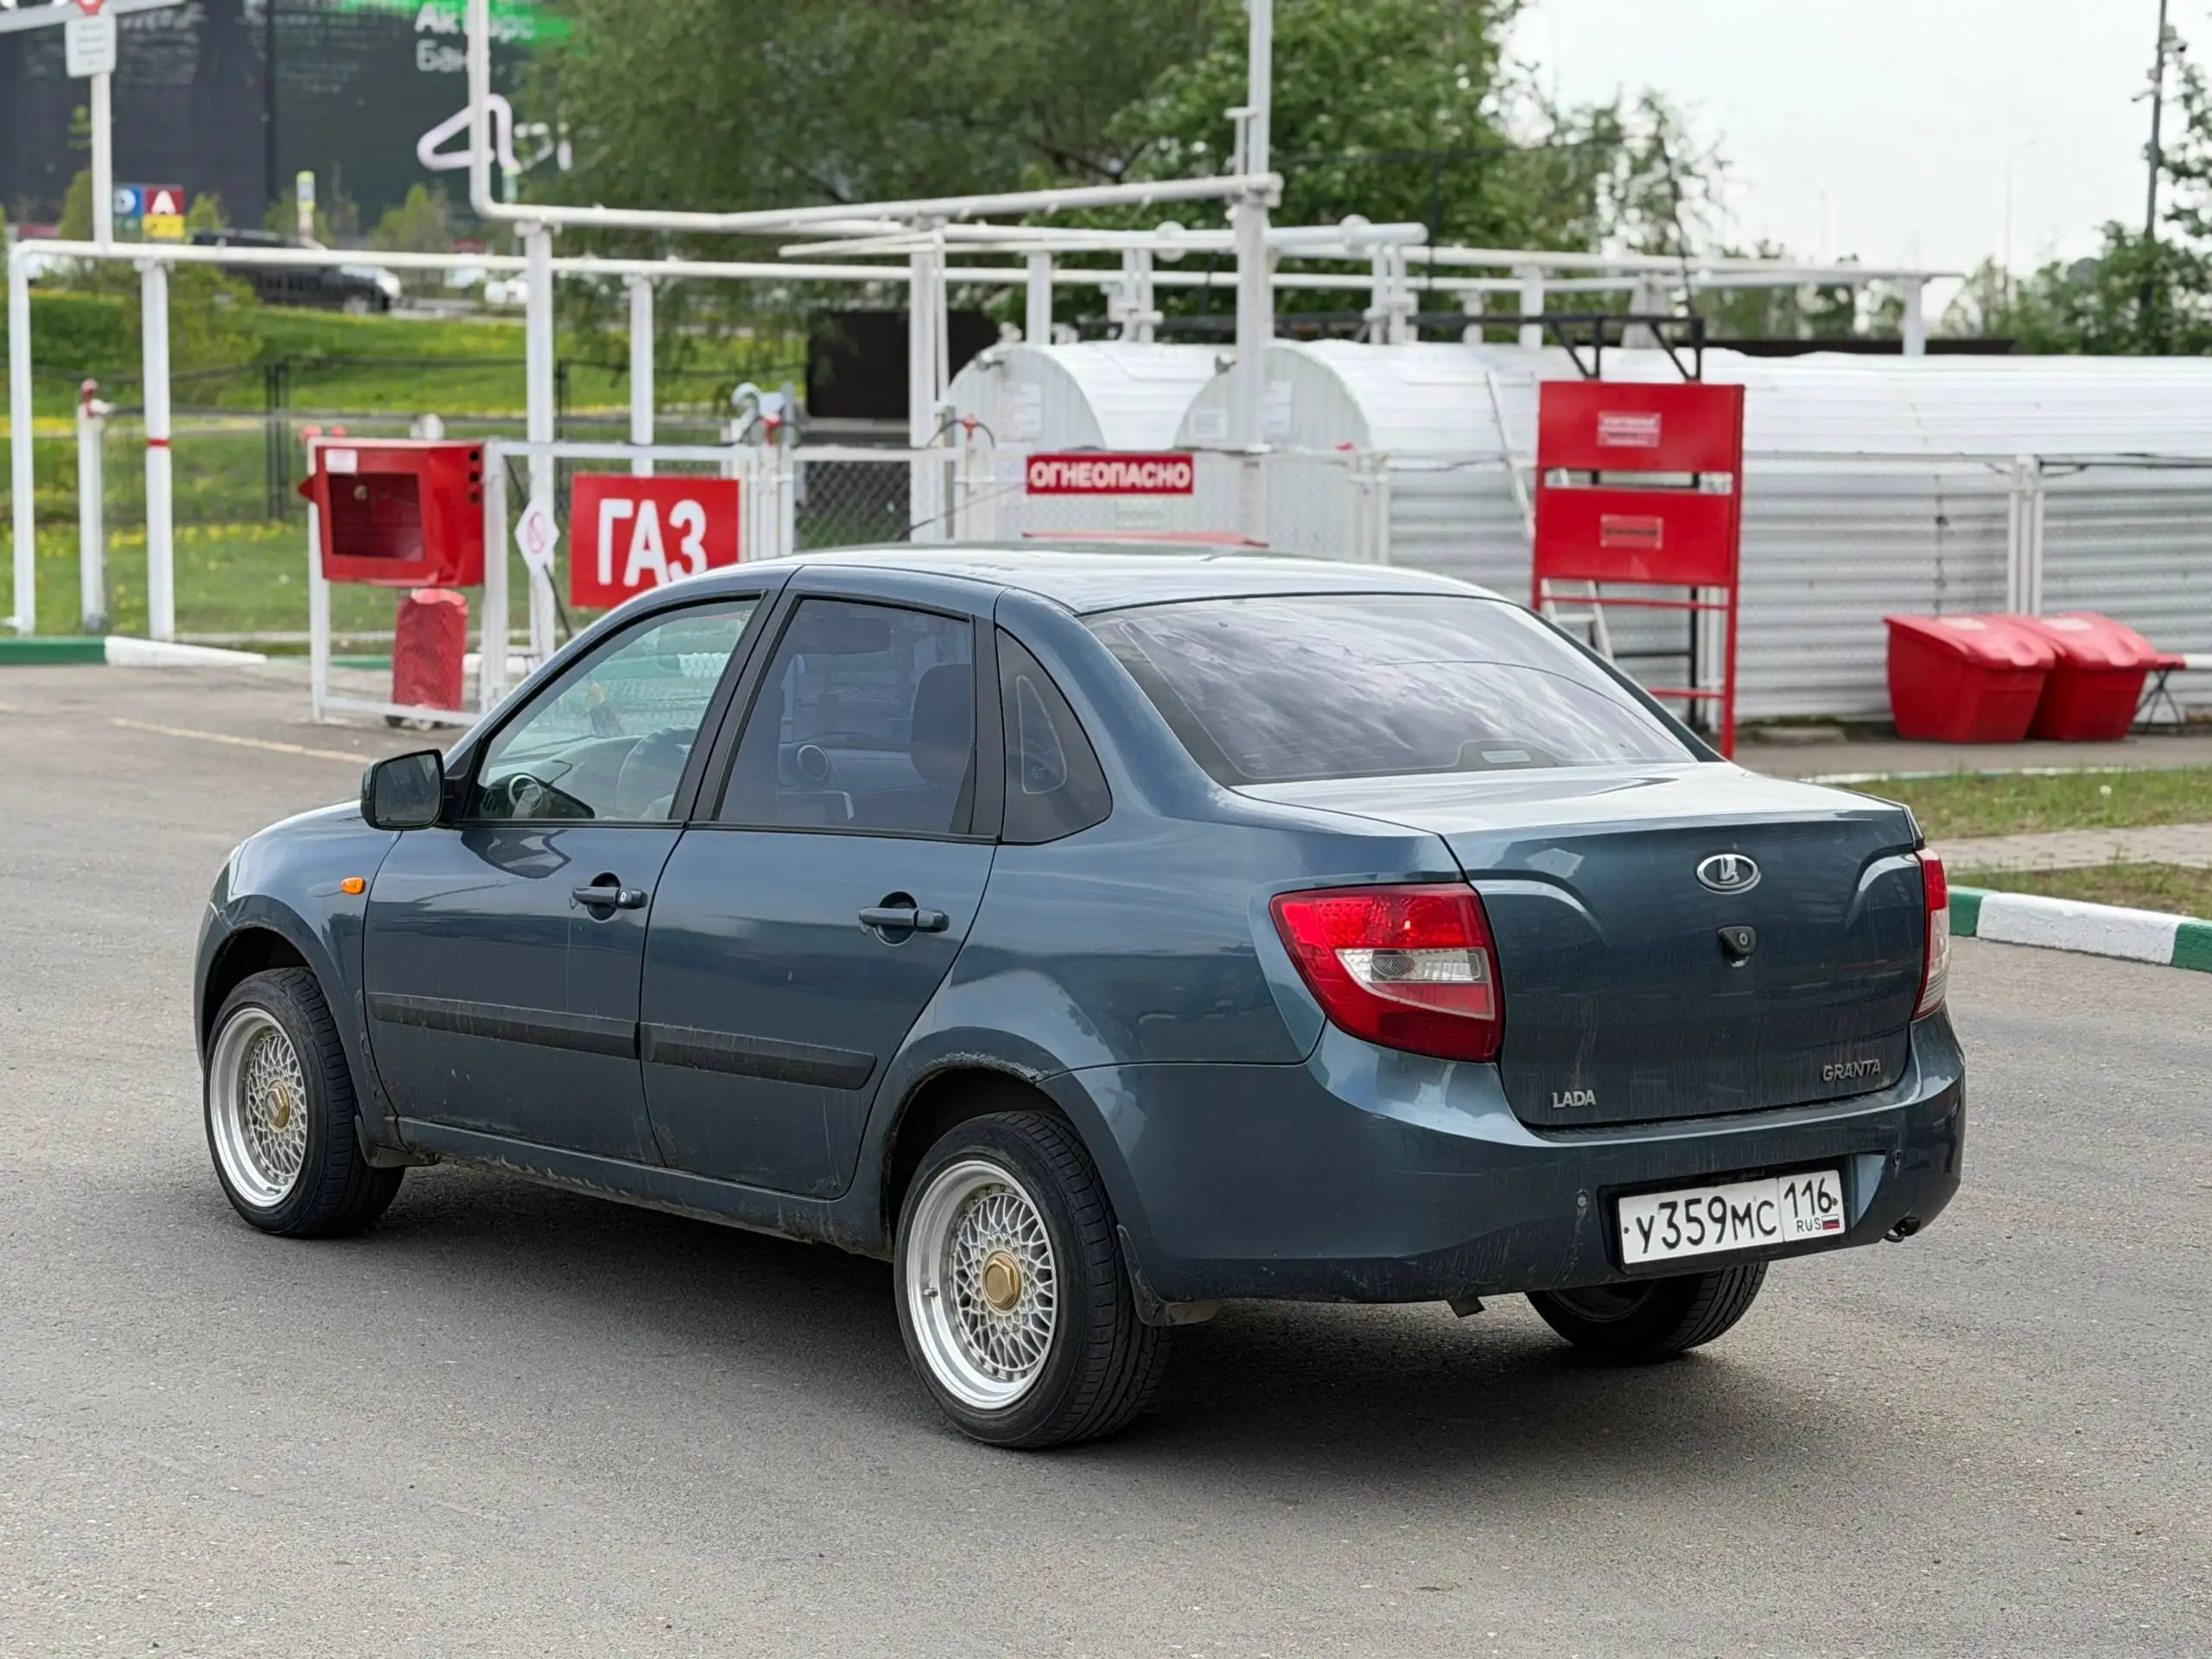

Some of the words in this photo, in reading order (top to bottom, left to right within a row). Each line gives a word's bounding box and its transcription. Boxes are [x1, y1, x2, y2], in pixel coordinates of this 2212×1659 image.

[416, 39, 490, 73] Бан
[1028, 461, 1192, 488] ОГНЕОПАСНО
[597, 498, 708, 588] ГАЗ
[1822, 1058, 1881, 1082] GRANTA
[1552, 1089, 1596, 1109] LADA
[1636, 1195, 1777, 1254] У359МС
[1783, 1177, 1833, 1218] 116
[1796, 1217, 1822, 1234] RUS
